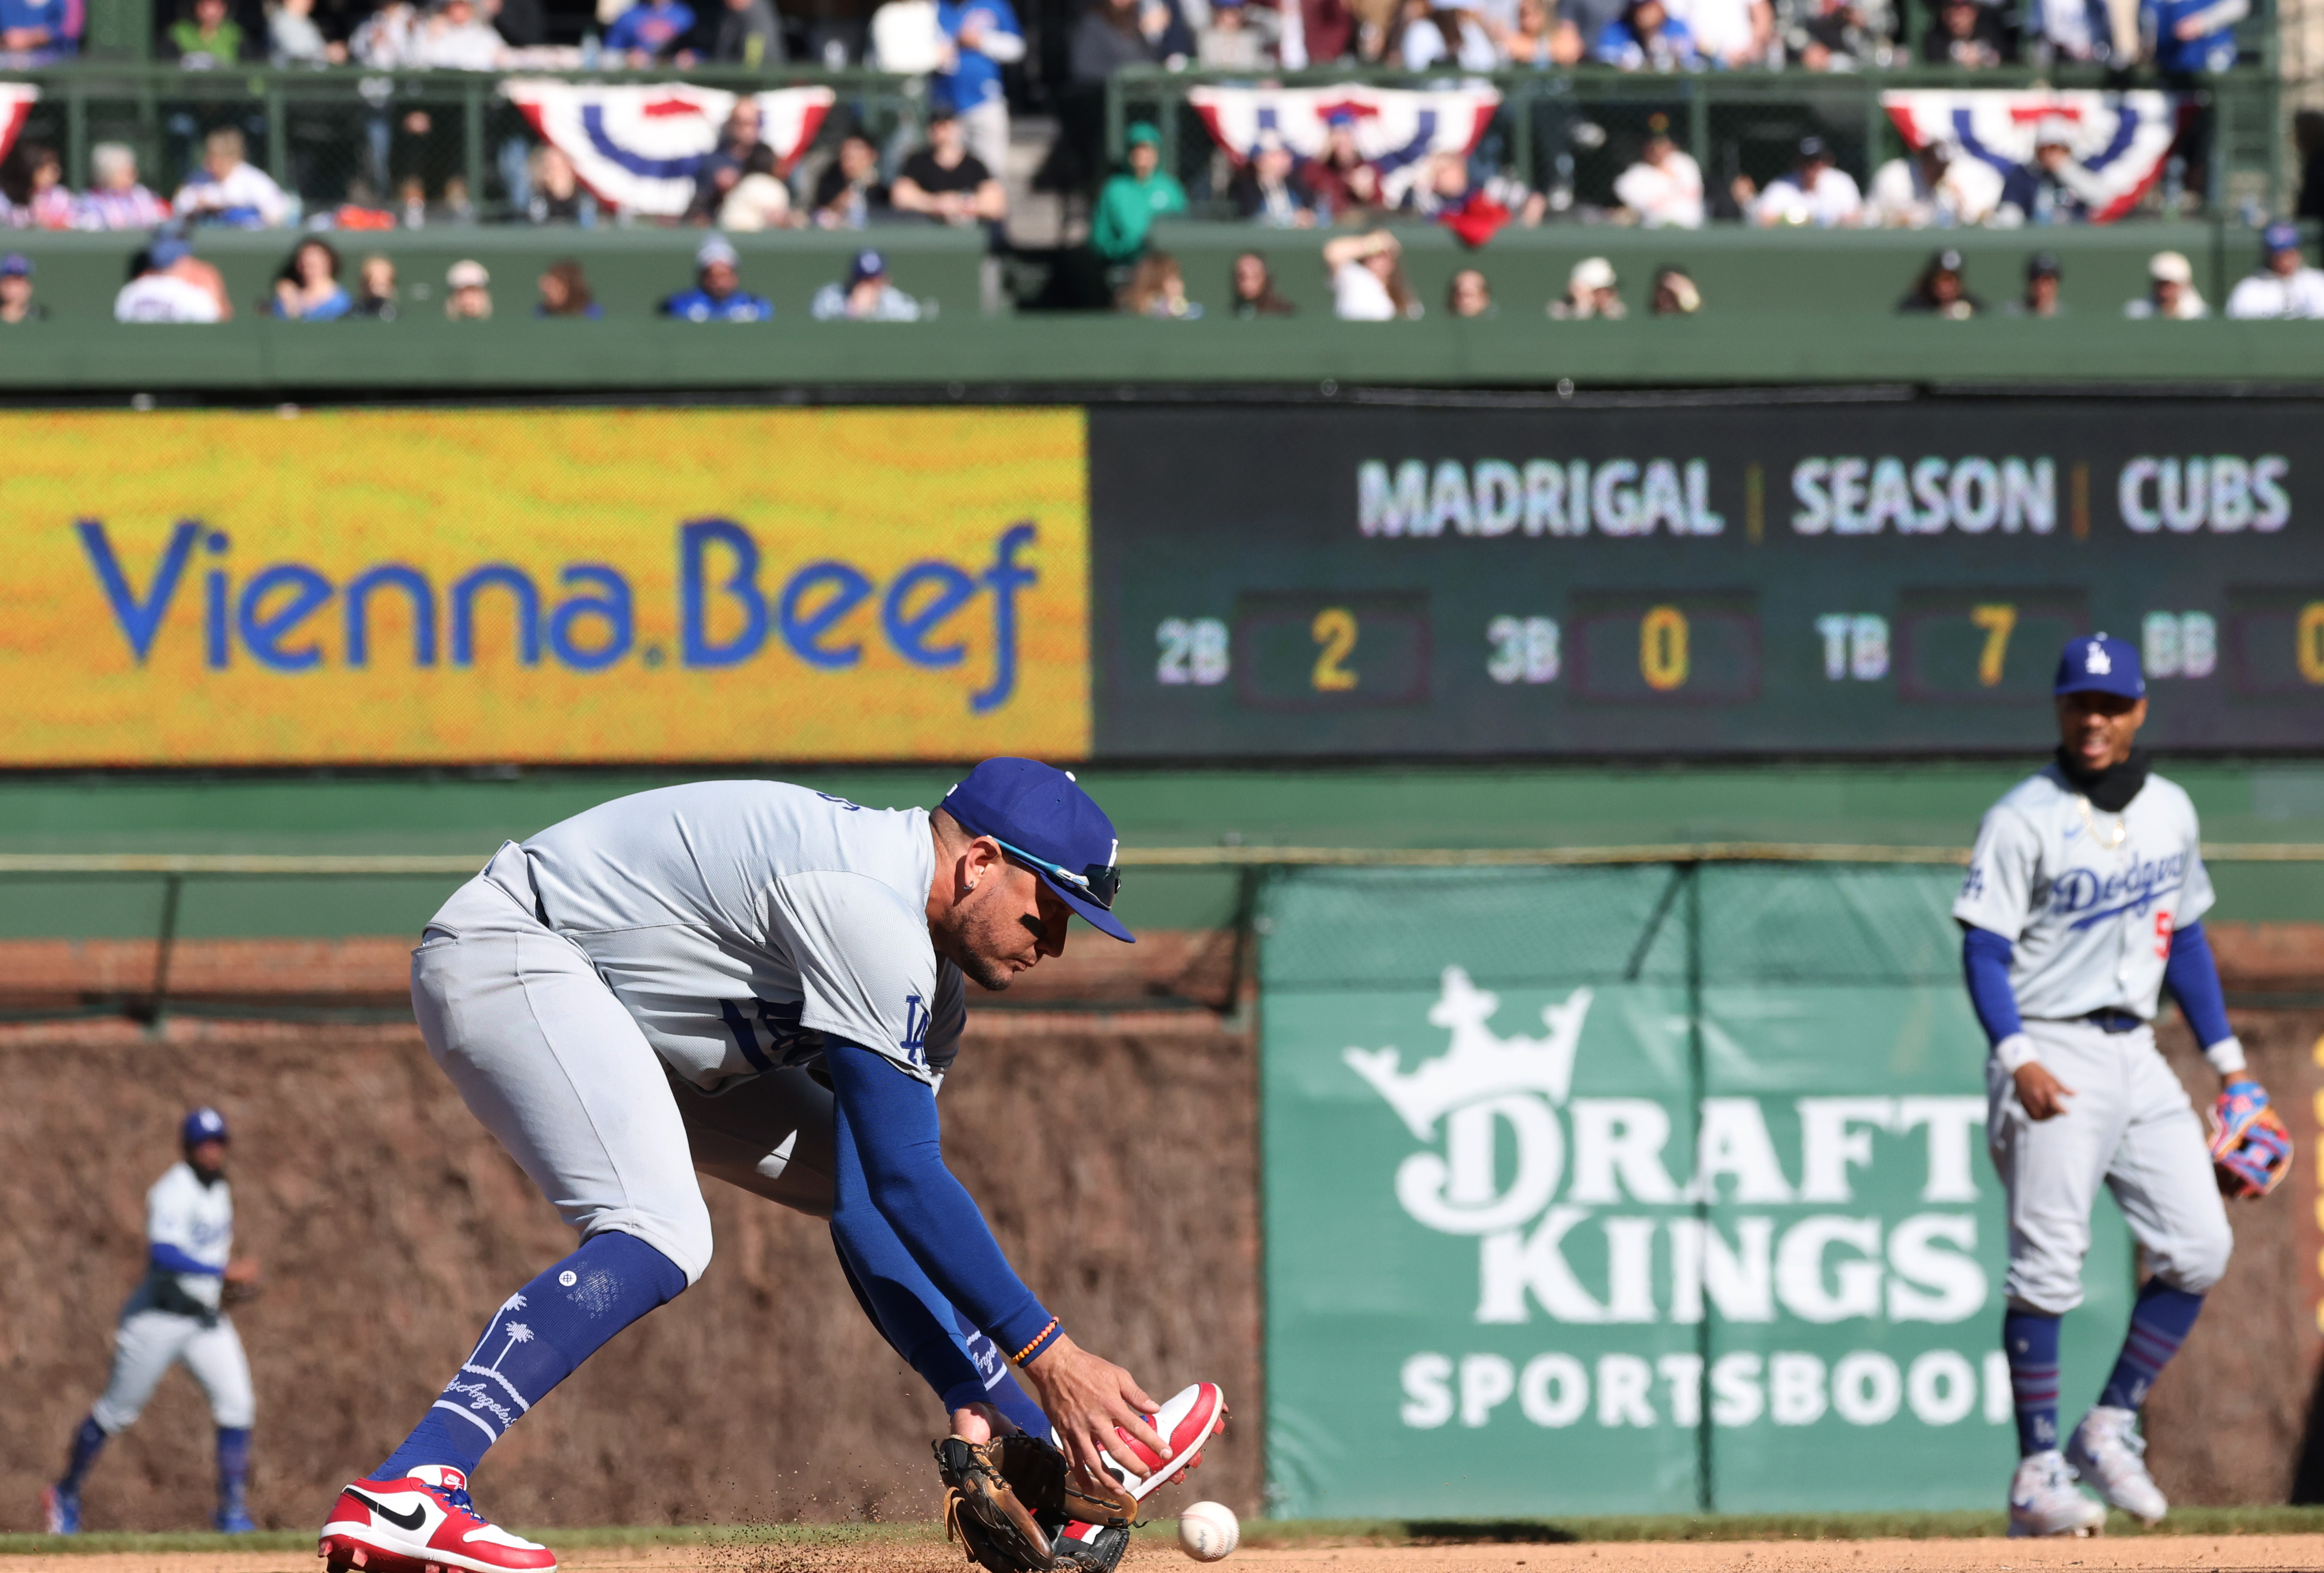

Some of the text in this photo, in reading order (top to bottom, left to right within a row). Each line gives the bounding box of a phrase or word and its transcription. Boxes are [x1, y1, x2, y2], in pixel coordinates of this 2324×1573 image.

[1357, 455, 2291, 537] MADRIGAL SEASON CUBS
[678, 519, 1038, 715] Beef
[1155, 617, 1231, 686] 2B
[1312, 608, 1357, 691] 2
[1486, 615, 1562, 685] 3B
[1639, 605, 1689, 690] 0
[1815, 613, 1891, 682] TB
[1971, 605, 2018, 687] 7
[2142, 611, 2218, 680] BB
[1393, 1092, 1989, 1233] DRAFT
[1473, 1204, 1989, 1324] KINGS
